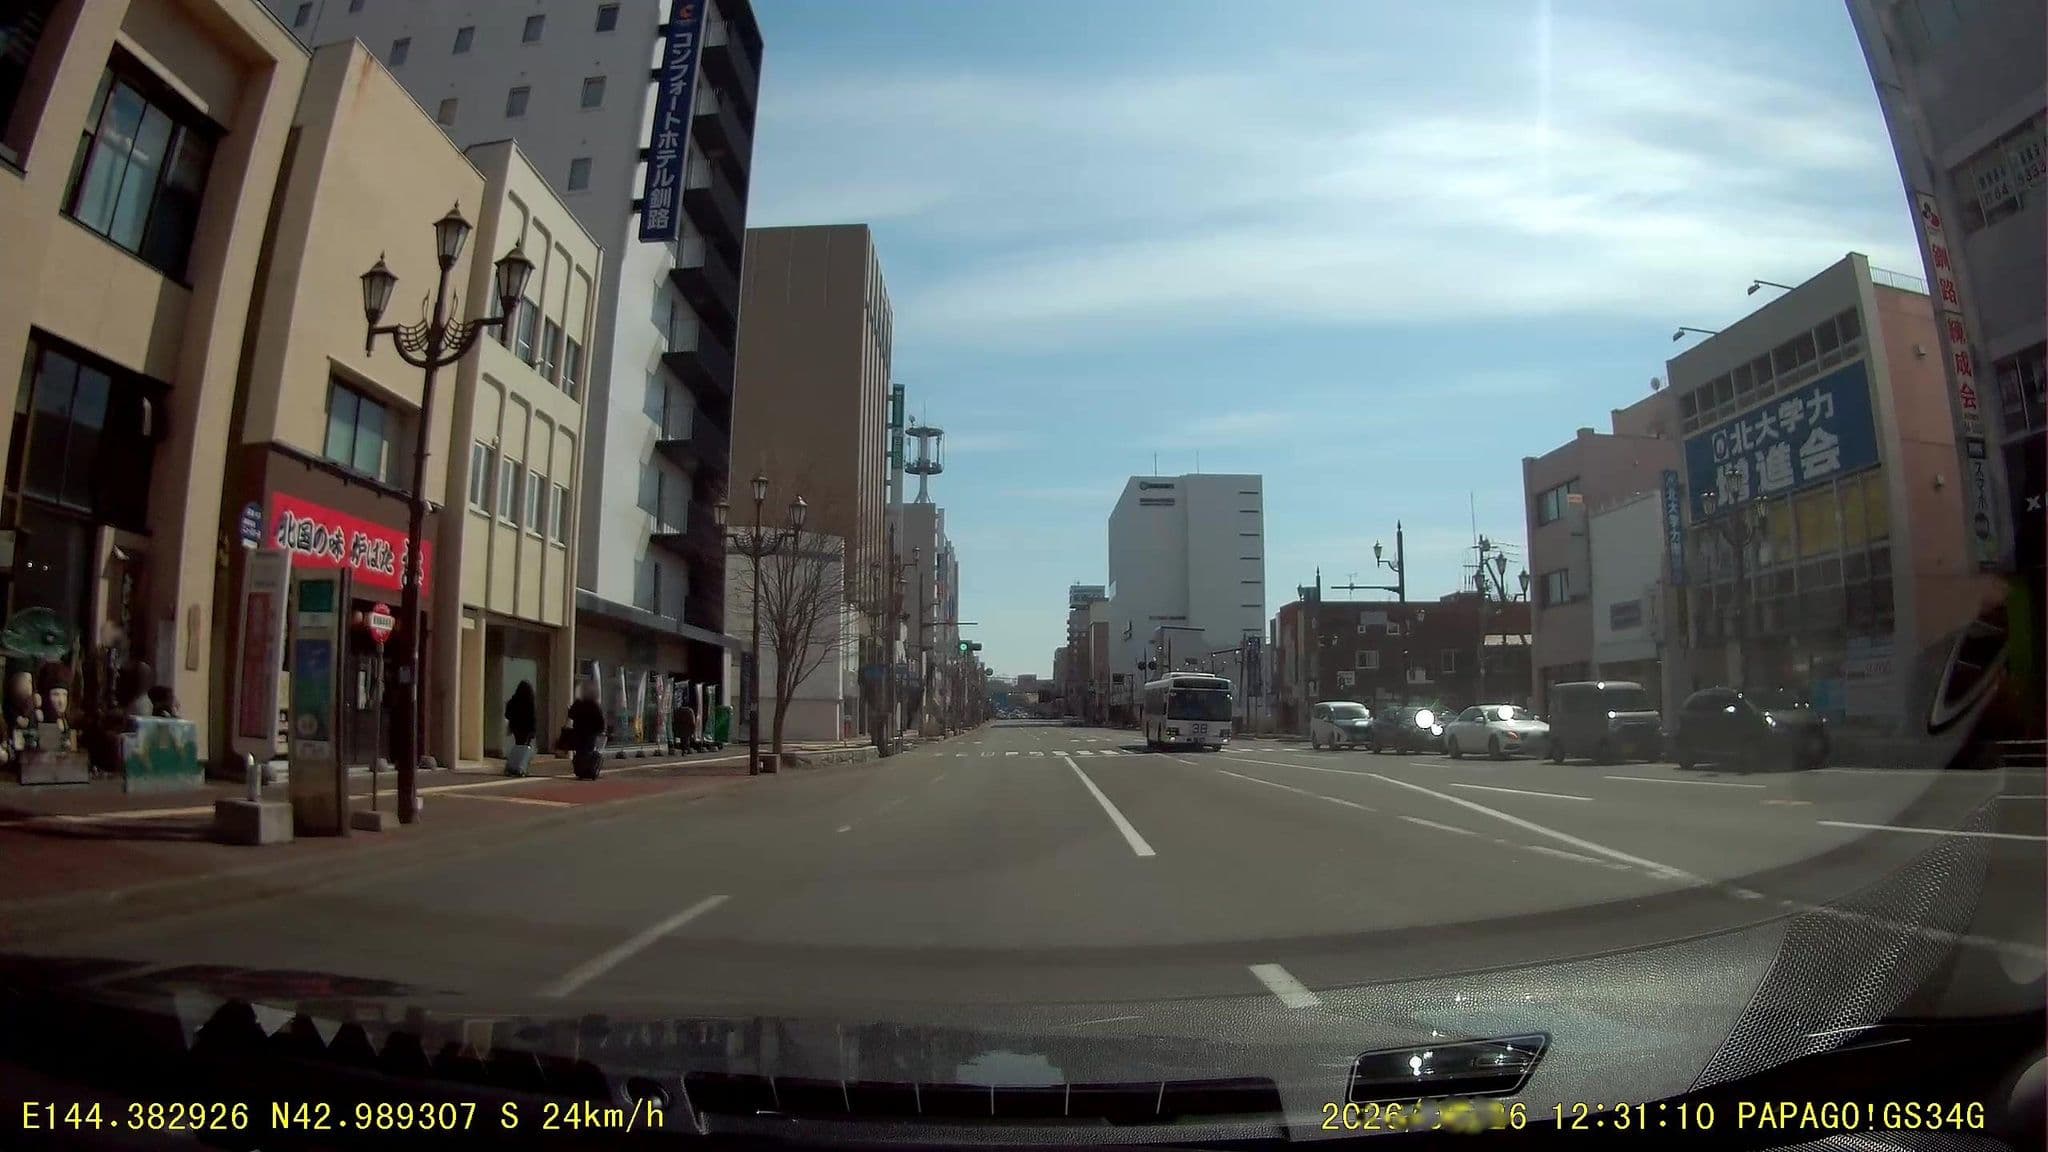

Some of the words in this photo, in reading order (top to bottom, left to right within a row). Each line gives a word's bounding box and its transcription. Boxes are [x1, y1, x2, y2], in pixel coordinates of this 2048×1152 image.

[648, 33, 693, 229] コンフォートホテル釧路
[1729, 389, 1834, 455] 北大学力
[278, 510, 345, 562] 北国の味
[351, 531, 394, 576] 炉ばた
